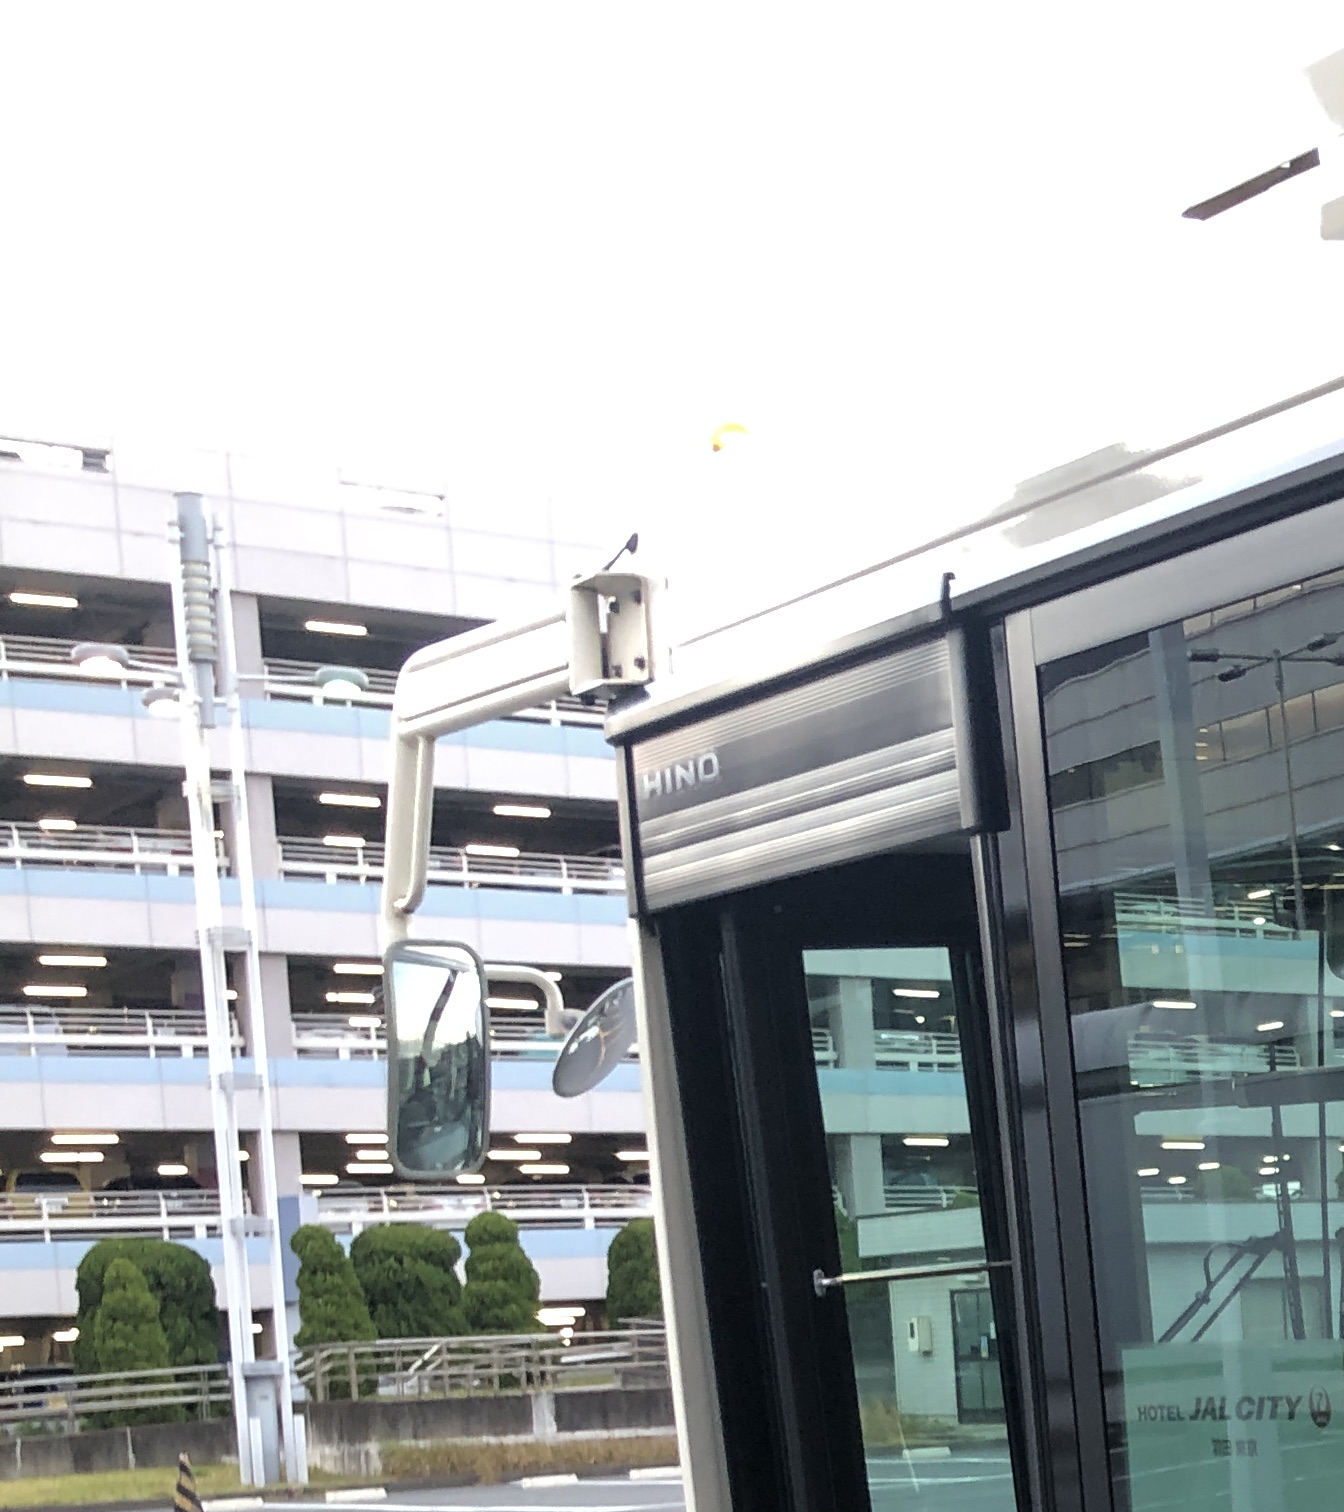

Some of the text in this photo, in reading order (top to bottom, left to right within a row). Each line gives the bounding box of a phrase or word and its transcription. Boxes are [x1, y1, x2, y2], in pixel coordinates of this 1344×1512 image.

[643, 752, 721, 799] HINO
[1137, 1405, 1185, 1422] HOTEL
[1189, 1396, 1231, 1421] JAL
[1235, 1395, 1302, 1421] CITY
